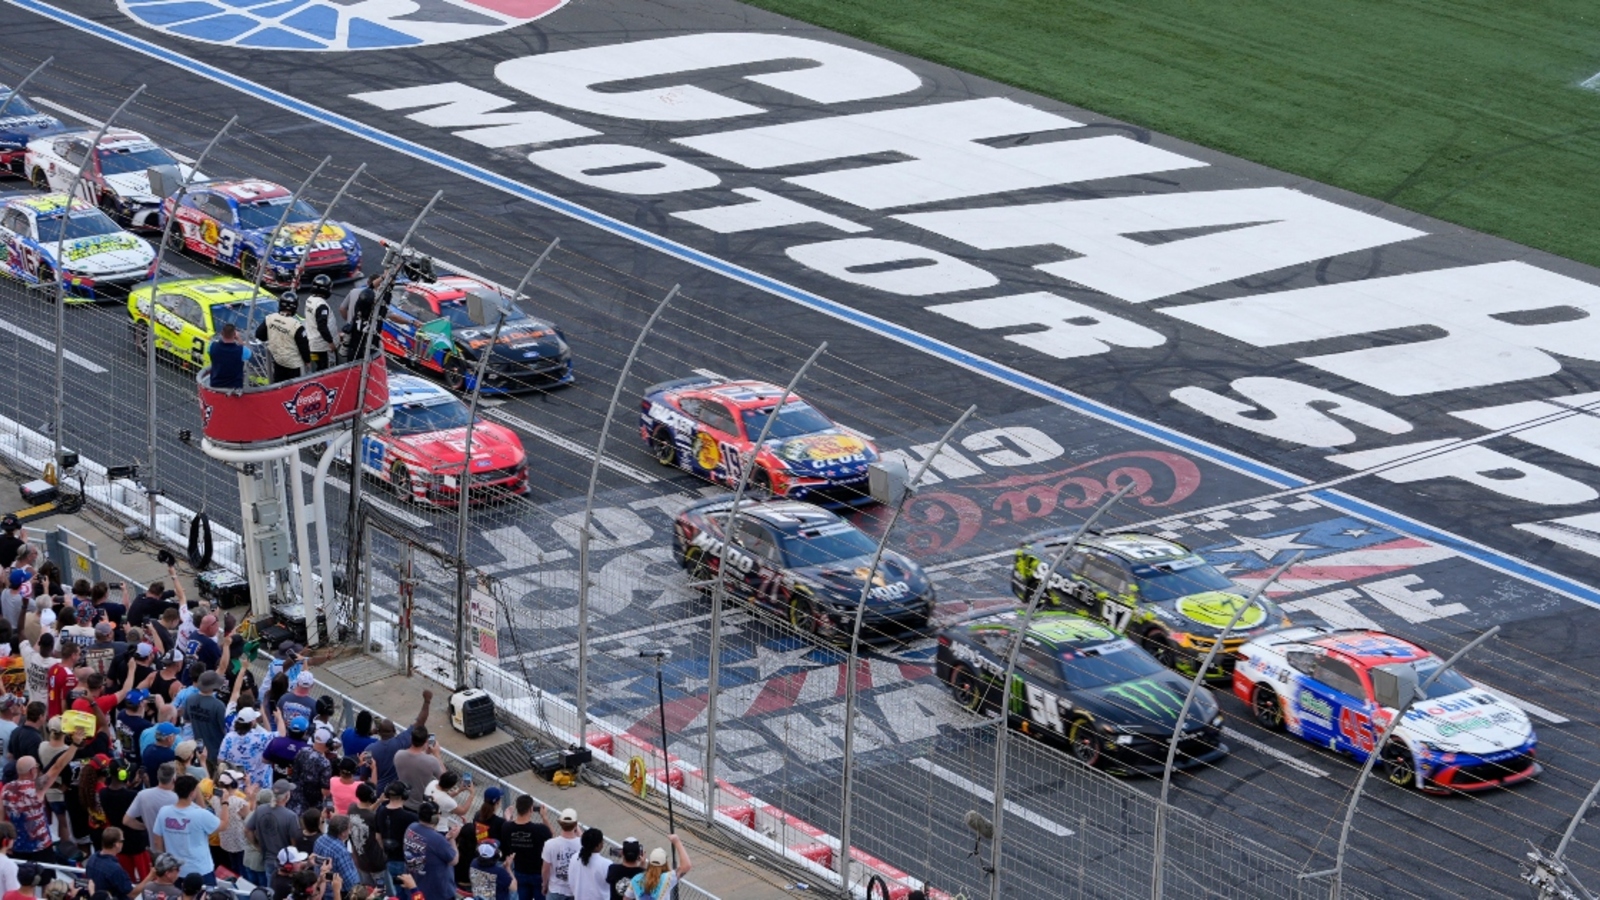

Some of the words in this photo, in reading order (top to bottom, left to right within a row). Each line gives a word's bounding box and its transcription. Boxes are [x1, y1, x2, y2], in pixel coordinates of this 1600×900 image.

[348, 82, 1167, 359] MOTOR
[218, 228, 236, 257] 3
[292, 240, 342, 255] CLUB
[302, 402, 321, 414] 600
[362, 437, 386, 472] 12
[719, 441, 742, 479] 19
[812, 453, 866, 469] CLUB
[758, 566, 784, 604] 71
[1102, 598, 1133, 633] 97
[1249, 653, 1278, 680] Mobil
[1025, 681, 1065, 734] 54
[1404, 698, 1476, 721] Mobil
[1340, 706, 1374, 754] 45
